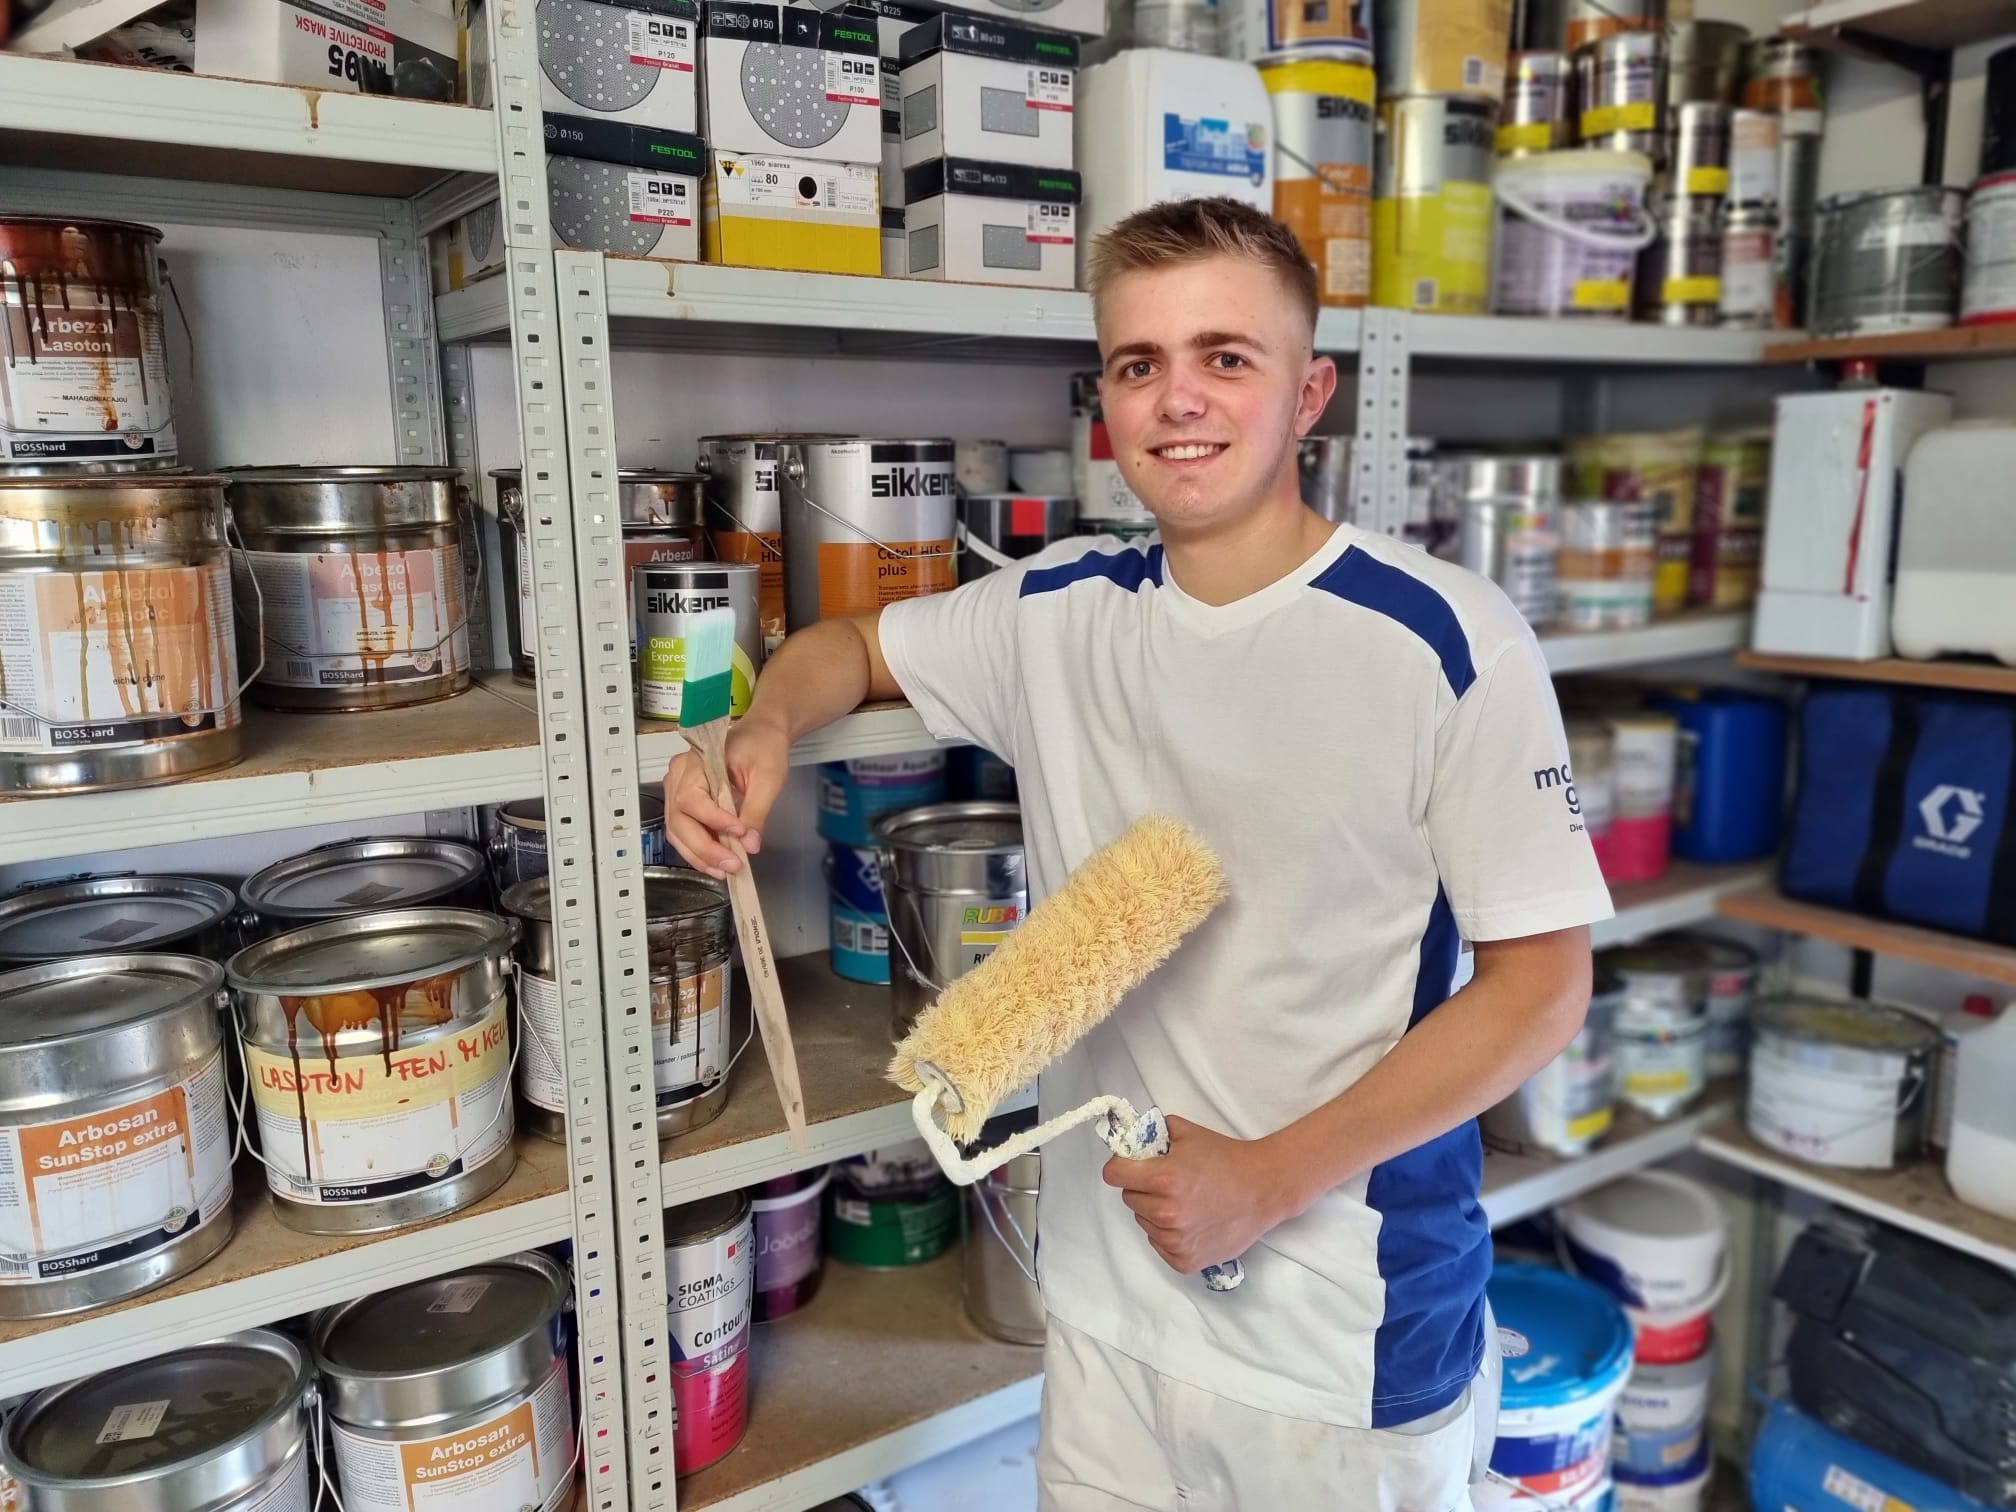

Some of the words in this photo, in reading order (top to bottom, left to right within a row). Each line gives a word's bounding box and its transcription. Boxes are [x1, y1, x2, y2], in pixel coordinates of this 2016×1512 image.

[295, 14, 326, 38] MASK
[834, 28, 874, 43] FESTOOL
[329, 27, 387, 59] PROTECTIVE
[658, 50, 675, 59] P120
[650, 144, 697, 159] FESTOOL
[750, 159, 766, 168] 1960
[765, 173, 778, 185] 80
[14, 442, 66, 452] BOSShard
[650, 548, 694, 562] Arbezol
[878, 564, 908, 579] plus
[650, 638, 675, 649] Onol
[260, 1065, 364, 1094] LASOTON
[58, 1107, 158, 1148] Arbosan
[39, 1139, 128, 1170] SunStop
[133, 1119, 177, 1147] extra
[322, 1185, 368, 1197] BOSShard
[42, 1252, 99, 1272] BOSShard
[678, 1273, 723, 1297] SIGMA
[678, 1277, 736, 1309] COATINGS
[694, 1309, 744, 1348] Contour
[430, 1423, 510, 1462] Arbosan
[415, 1454, 485, 1479] SunStop
[489, 1431, 526, 1458] extra
